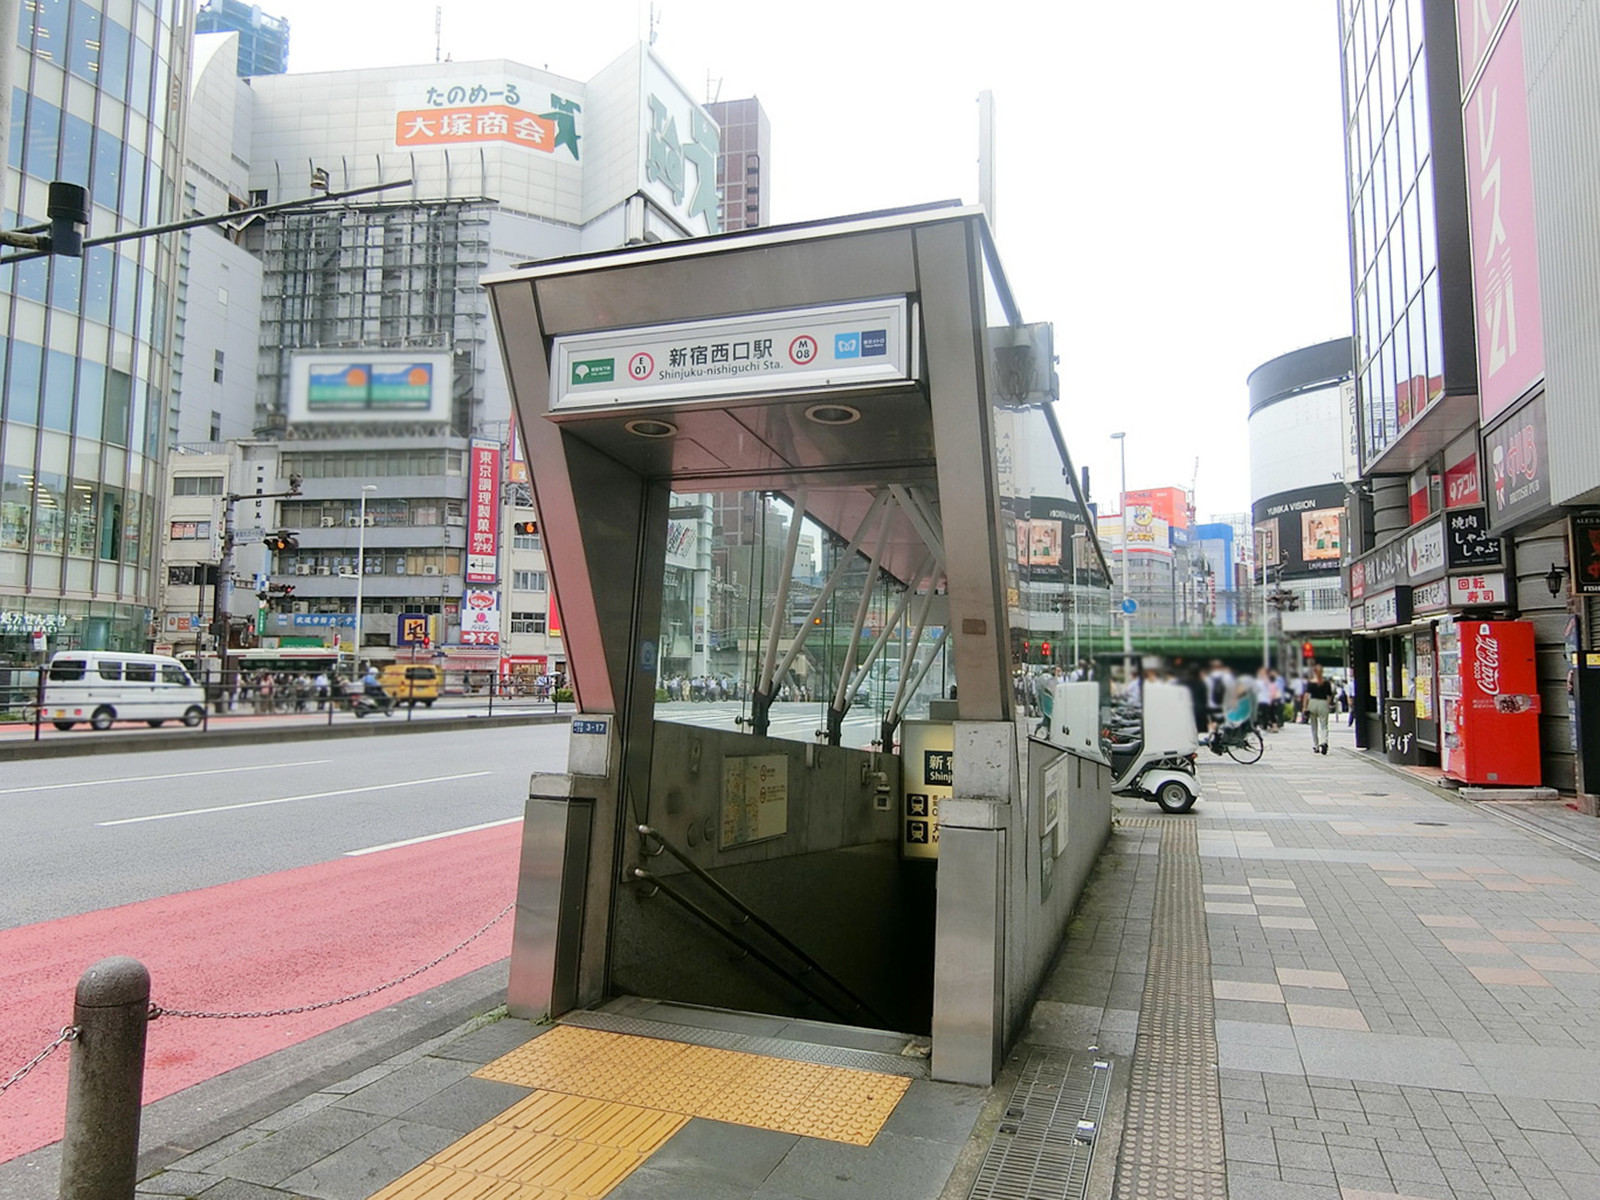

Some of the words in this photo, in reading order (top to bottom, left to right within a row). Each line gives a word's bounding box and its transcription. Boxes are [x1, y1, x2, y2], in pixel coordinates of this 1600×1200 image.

[426, 84, 521, 107] たのめーる
[404, 112, 545, 144] 大塚商会
[798, 340, 808, 348] M
[639, 357, 644, 365] E
[669, 338, 773, 368] 新宿西口駅
[796, 349, 810, 360] 08
[634, 366, 647, 375] 01
[659, 361, 760, 380] Shinjuku-nishiguchi
[1507, 425, 1537, 488] HUB
[477, 451, 493, 532] 東京調理製菓
[1457, 470, 1477, 499] アコム
[1266, 505, 1290, 516] YUNIKA
[1289, 499, 1316, 512] VISION
[1451, 514, 1478, 529] 焼肉
[472, 543, 493, 553] 学校
[1463, 541, 1499, 557] しゃぶ
[1457, 577, 1486, 591] 回転
[1467, 590, 1494, 603] 寿司
[0, 611, 67, 627] 処方せん受付
[477, 632, 497, 643] すぐ
